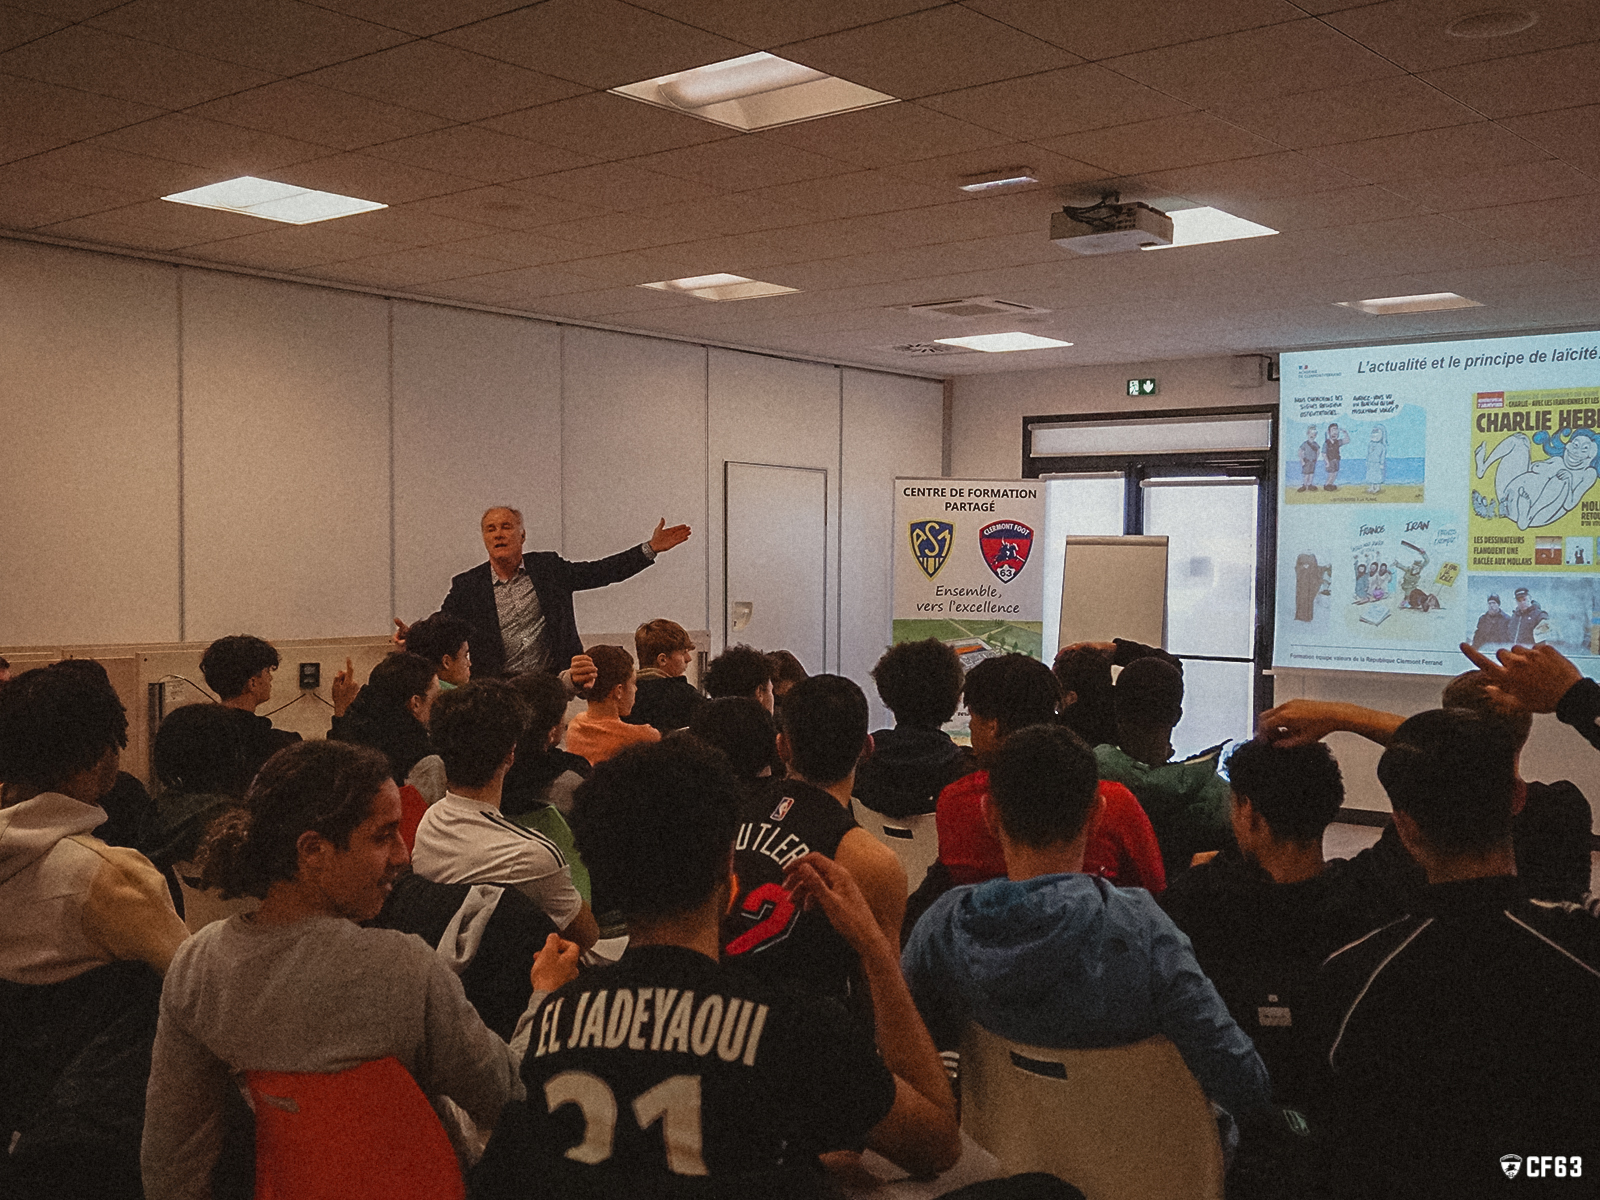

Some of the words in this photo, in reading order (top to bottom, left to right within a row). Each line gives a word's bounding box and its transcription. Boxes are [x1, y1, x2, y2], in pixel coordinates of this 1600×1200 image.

[1358, 357, 1427, 374] L'actualité
[1431, 357, 1445, 369] et
[1448, 355, 1461, 368] le
[1464, 352, 1525, 370] principe
[1529, 350, 1547, 363] de
[1476, 410, 1552, 433] CHARLIE
[1559, 408, 1600, 430] HEB
[903, 487, 947, 498] CENTRE
[950, 488, 965, 498] DE
[968, 488, 1037, 499] FORMATION
[944, 500, 996, 512] PARTAGÉ
[1581, 500, 1600, 512] MOL
[983, 523, 1014, 536] CLERMONT
[1014, 524, 1030, 536] FOOT
[1359, 524, 1386, 537] FRANCE
[1404, 521, 1430, 532] IRAN
[1473, 536, 1483, 544] LES
[1484, 536, 1525, 544] DESSINATEURS
[1506, 546, 1519, 555] UNE
[1494, 557, 1506, 565] AUX
[1000, 569, 1012, 577] 63
[935, 584, 1002, 599] Ensemble,
[916, 602, 943, 612] vers
[948, 600, 1020, 614] l'excellence
[735, 822, 810, 870] UTLER
[534, 997, 565, 1058] EL
[566, 987, 770, 1067] JADEYAOUI
